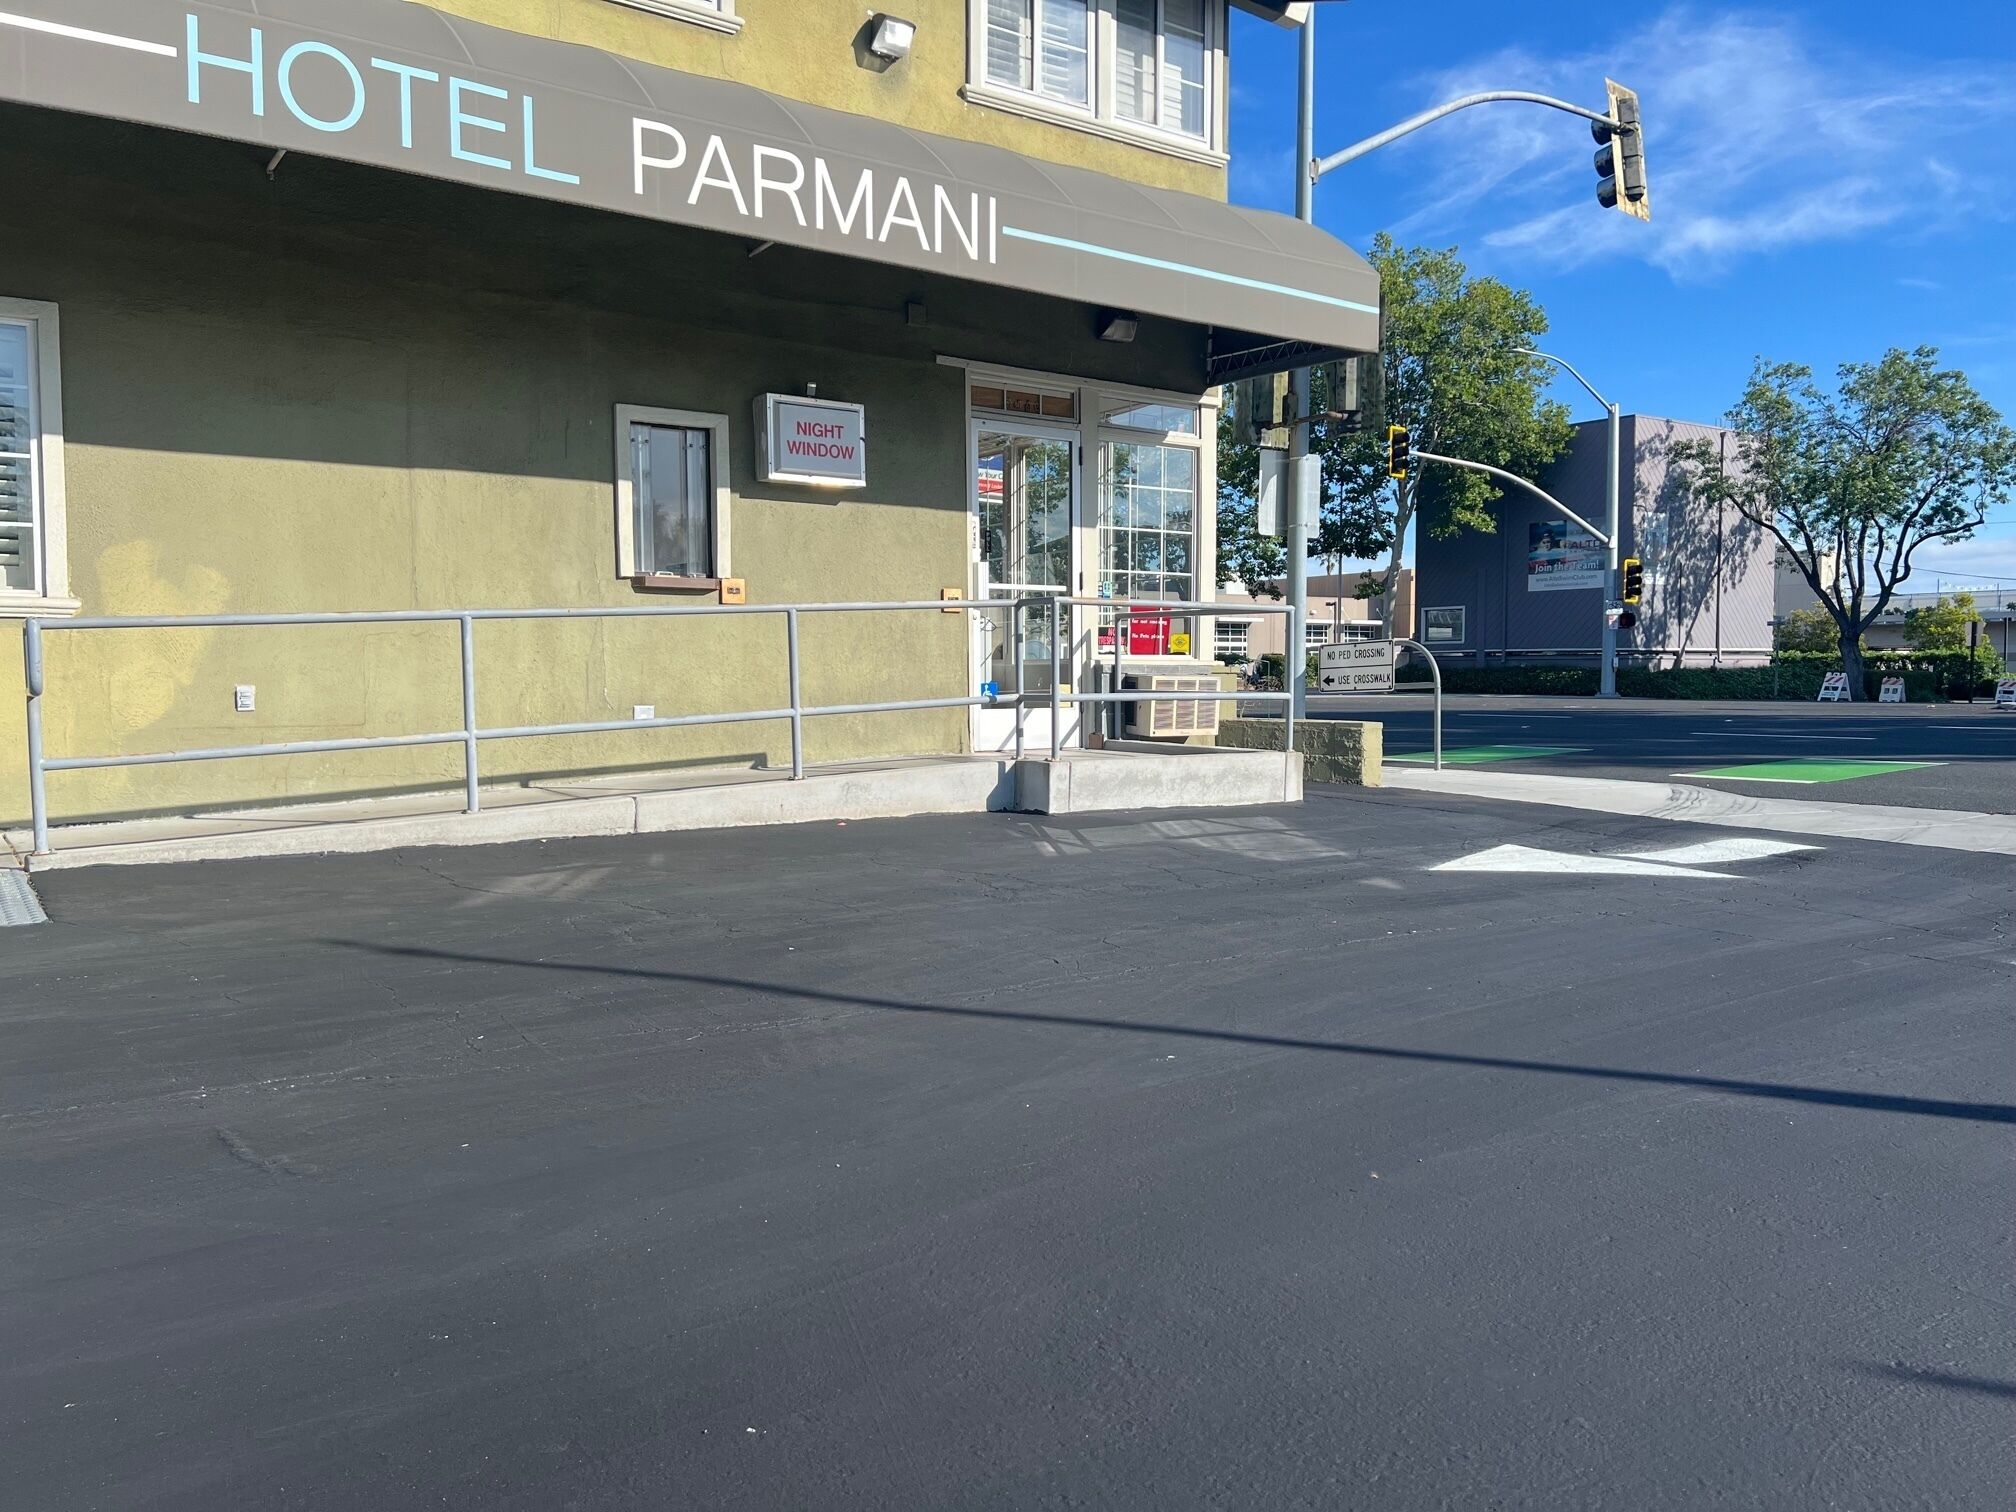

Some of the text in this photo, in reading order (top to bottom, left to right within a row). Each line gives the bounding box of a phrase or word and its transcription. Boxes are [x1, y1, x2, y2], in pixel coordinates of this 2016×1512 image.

[186, 13, 997, 265] HOTEL PARMANI
[796, 420, 844, 439] NIGHT
[786, 440, 855, 460] WINDOW
[1534, 559, 1599, 574] Join the Team!
[1327, 647, 1385, 661] NO PED CROSSING
[1338, 673, 1391, 685] USE CROSSWALK
